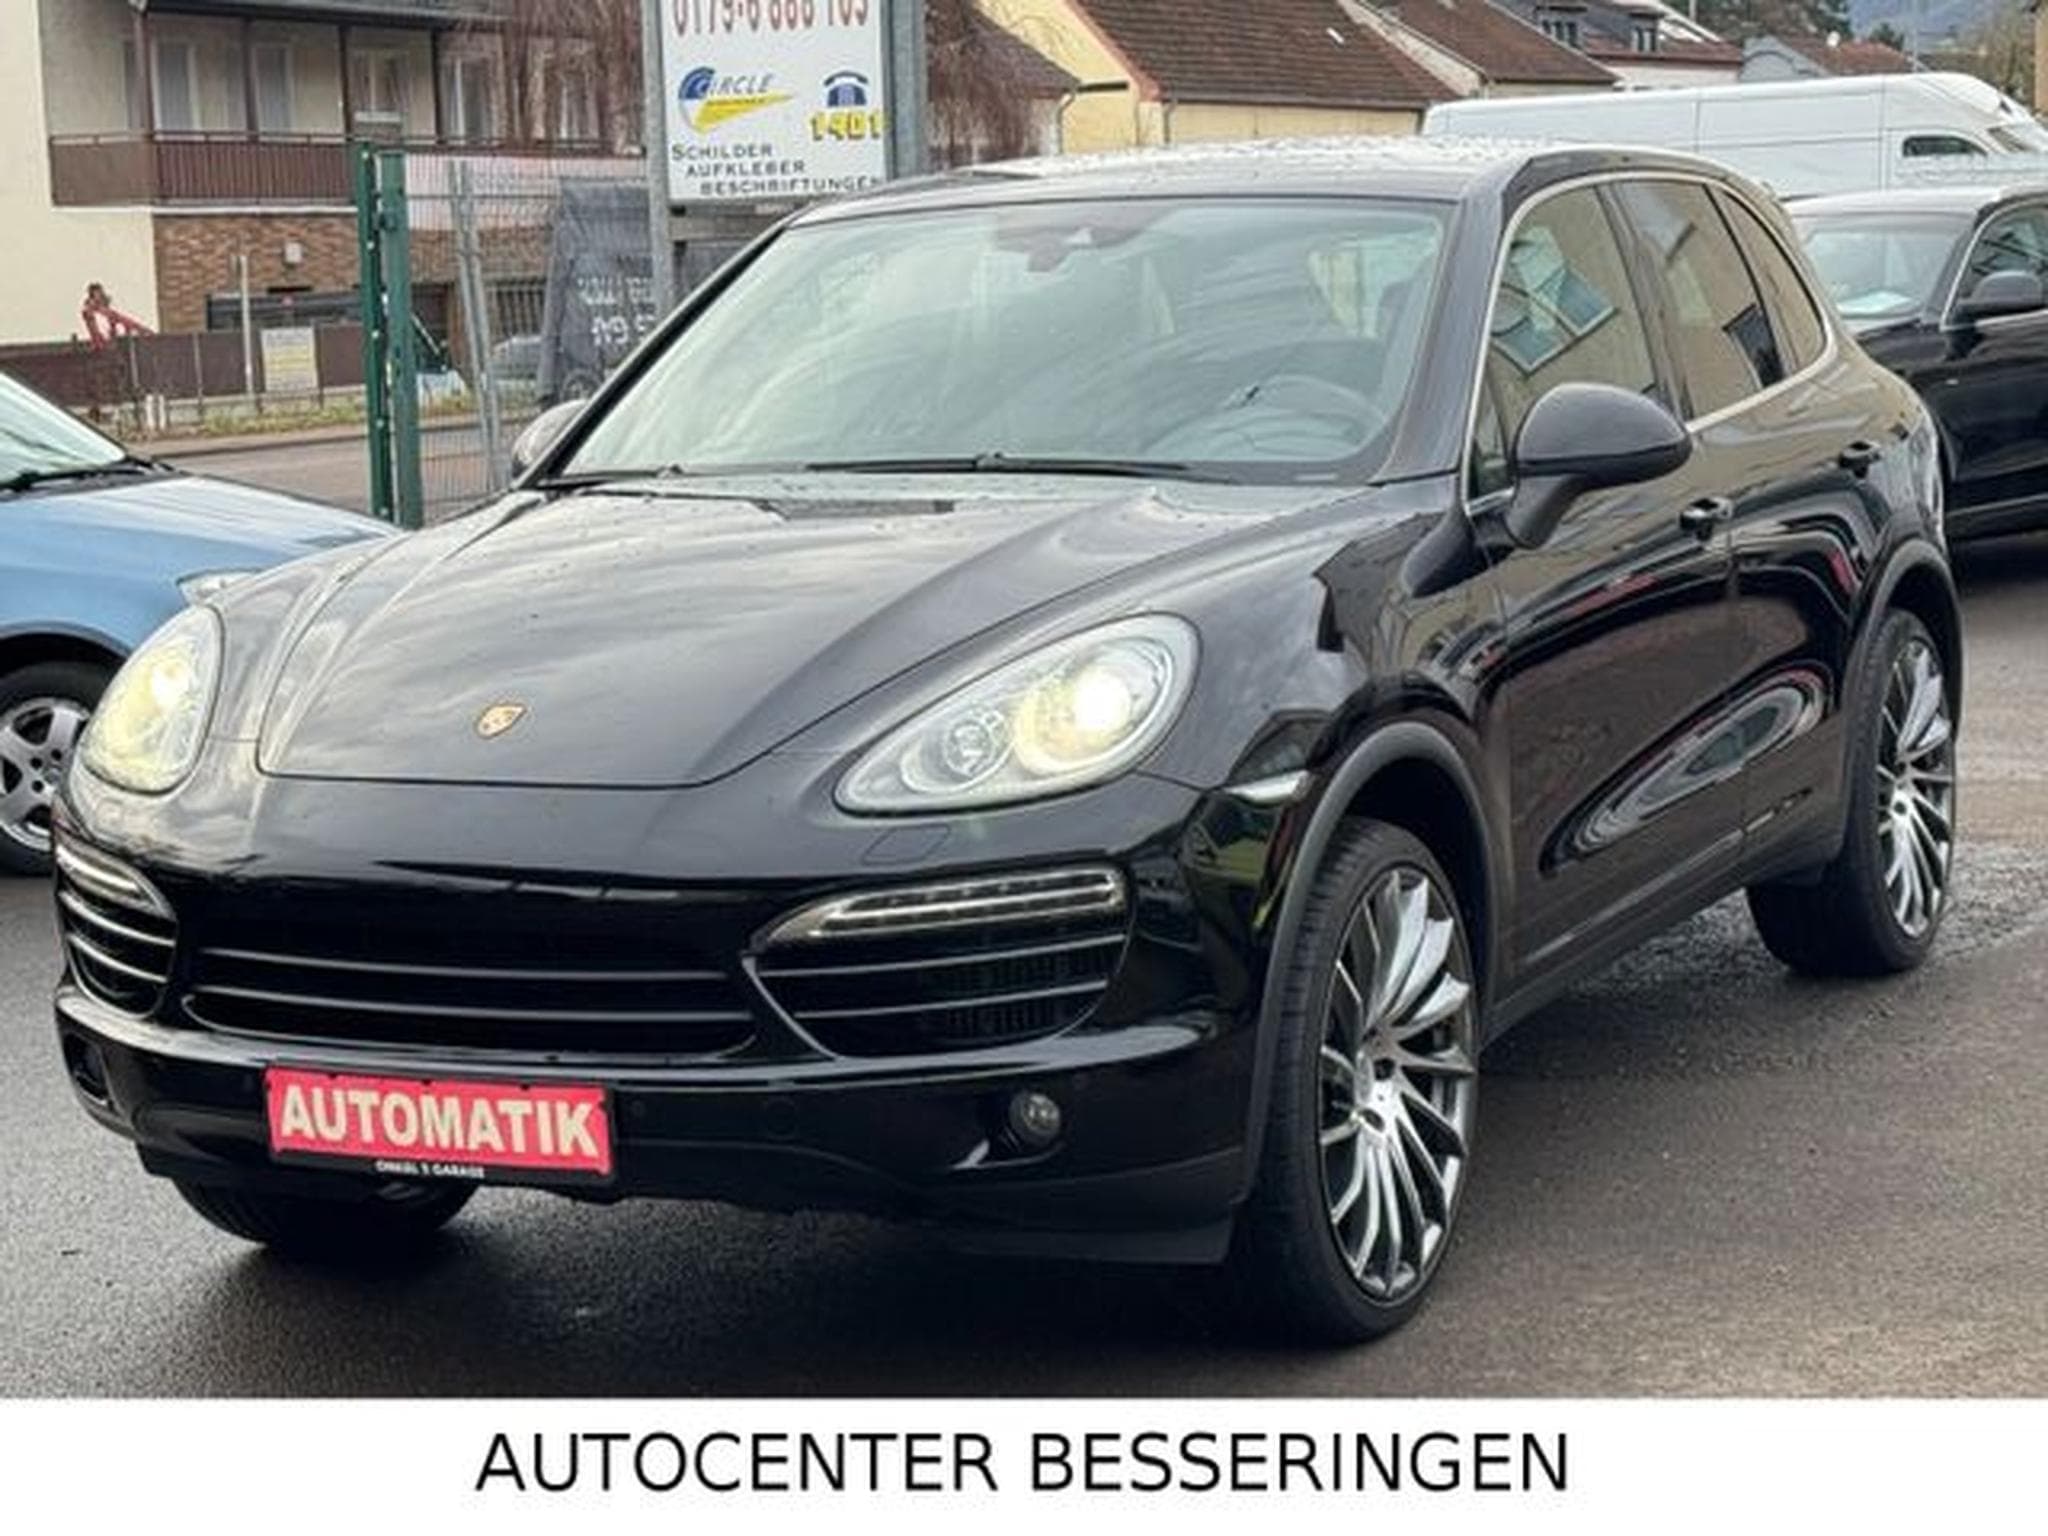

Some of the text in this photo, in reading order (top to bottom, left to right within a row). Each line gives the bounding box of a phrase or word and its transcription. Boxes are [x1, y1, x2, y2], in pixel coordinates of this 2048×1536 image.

[671, 144, 773, 161] SCHILDER
[686, 160, 806, 178] AUFKLEBER
[281, 1084, 600, 1157] AUTOMATIK
